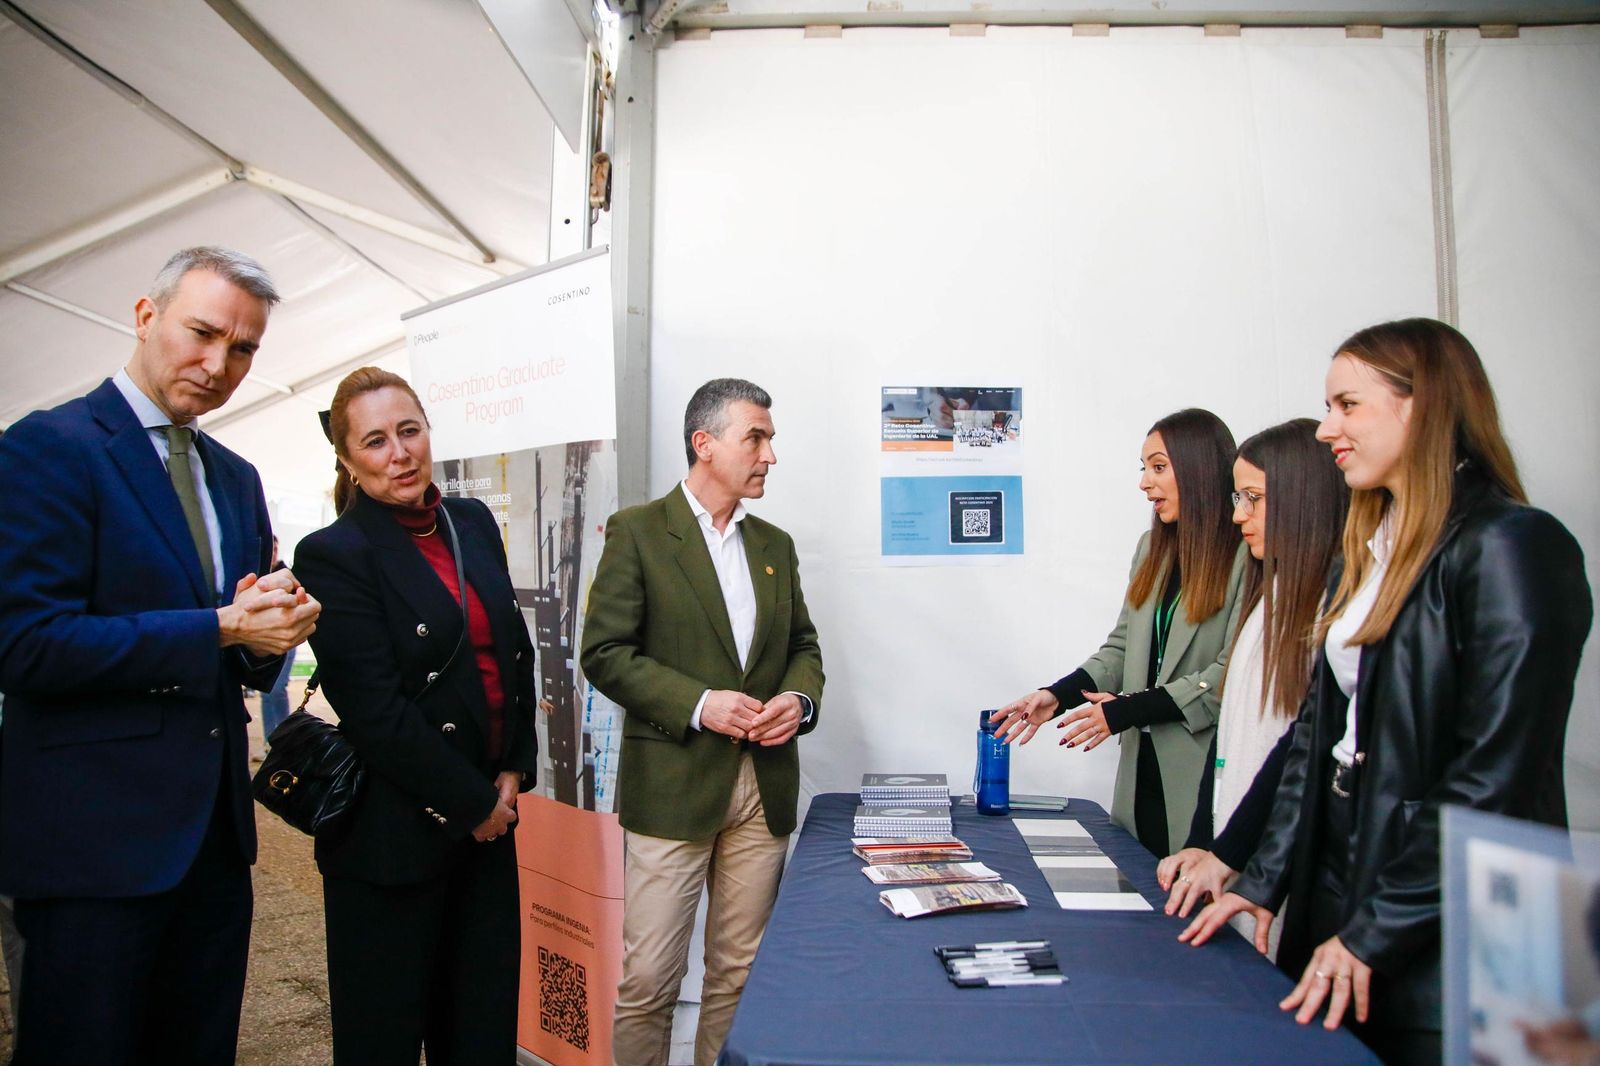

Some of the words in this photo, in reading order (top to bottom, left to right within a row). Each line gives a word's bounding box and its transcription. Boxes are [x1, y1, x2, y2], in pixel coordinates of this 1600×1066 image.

[547, 286, 591, 306] COSENTINO
[427, 372, 495, 404] Cosentino
[497, 356, 567, 389] Graduate
[465, 395, 525, 425] Program
[440, 477, 474, 490] brillante
[486, 493, 512, 507] ganas
[530, 912, 544, 925] Para
[531, 902, 566, 923] PROGRAMA
